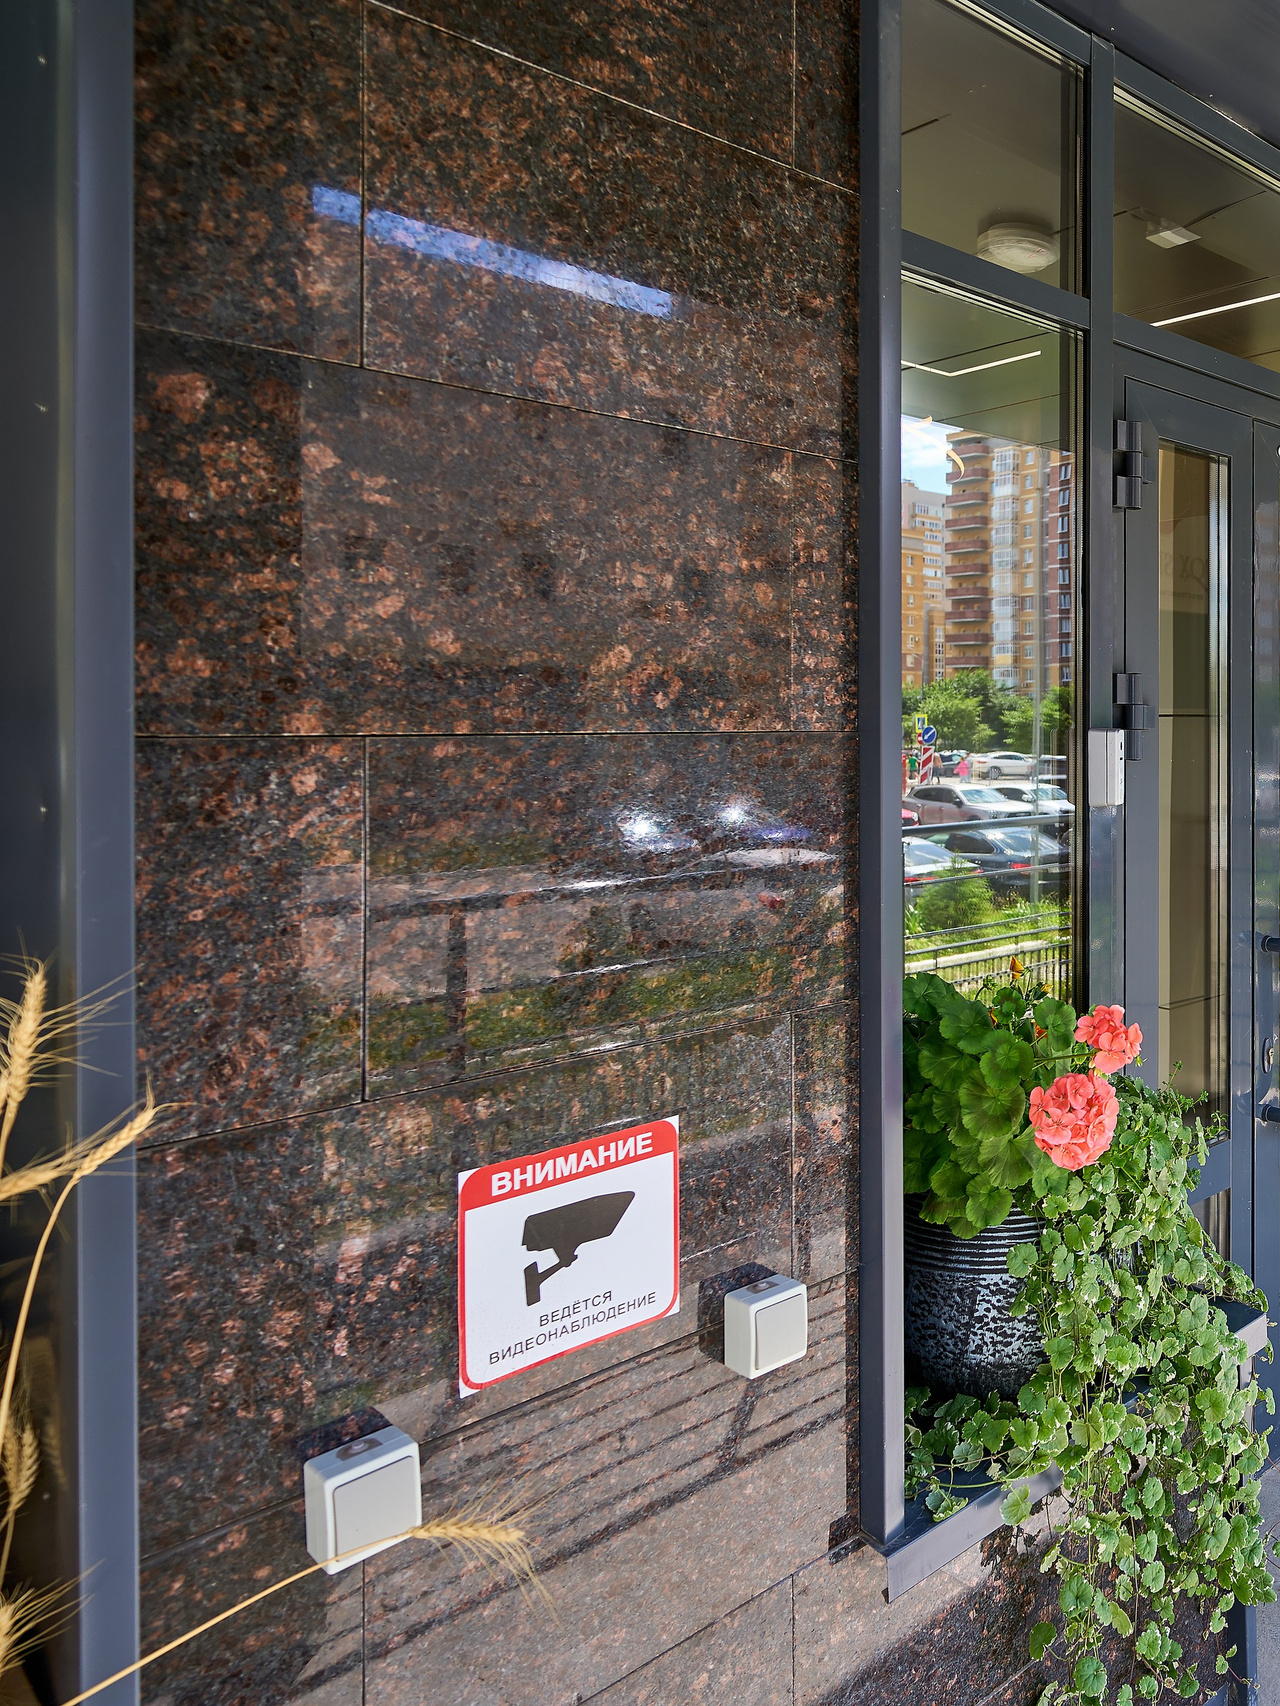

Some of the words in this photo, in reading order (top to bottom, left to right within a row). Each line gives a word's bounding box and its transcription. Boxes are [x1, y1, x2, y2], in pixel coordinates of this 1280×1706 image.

[491, 1131, 653, 1197] ВНИМАНИЕ
[489, 1291, 657, 1365] ВИДЕОНАБЛЮДЕНИЕ
[539, 1290, 613, 1327] ВЕДЁТСЯ
